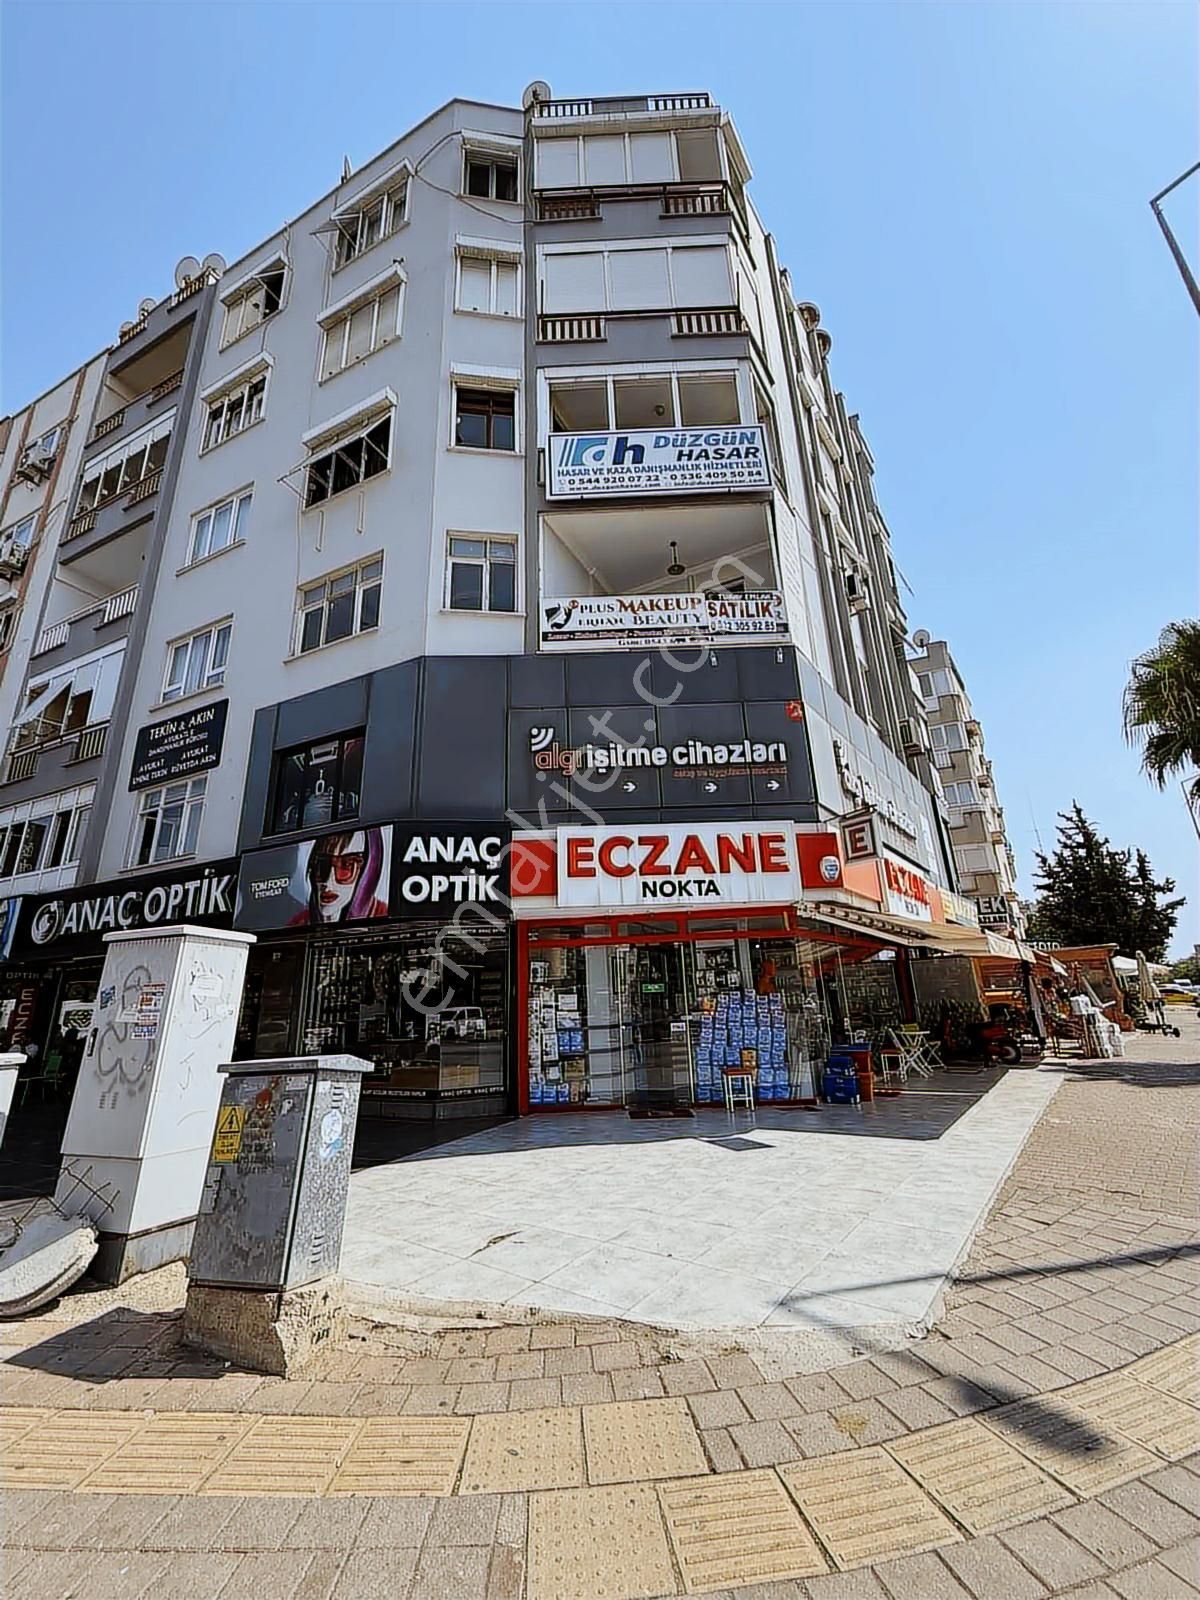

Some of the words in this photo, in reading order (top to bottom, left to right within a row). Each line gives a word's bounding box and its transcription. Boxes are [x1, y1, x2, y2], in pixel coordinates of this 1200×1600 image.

[558, 467, 591, 478] HASAR
[591, 467, 605, 476] VE
[606, 466, 633, 475] KAZA
[633, 463, 702, 475] DANIŞMANLIK
[703, 458, 763, 471] HİZMETLERİ
[676, 446, 761, 462] HASAR
[580, 603, 615, 614] PLUS
[615, 596, 702, 616] MAKEUP
[633, 612, 702, 626] BEAUTY
[150, 720, 178, 740] TEKİN
[188, 708, 215, 728] AKIN
[586, 742, 669, 774] işitme
[672, 738, 787, 765] cihazları
[403, 835, 501, 869] ANAÇ
[566, 830, 791, 878] ECZANE
[850, 827, 868, 854] E
[60, 892, 140, 930] ANAÇ
[143, 868, 232, 923] OPTİK
[401, 868, 501, 903] OPTİK
[641, 879, 721, 898] NOKTA
